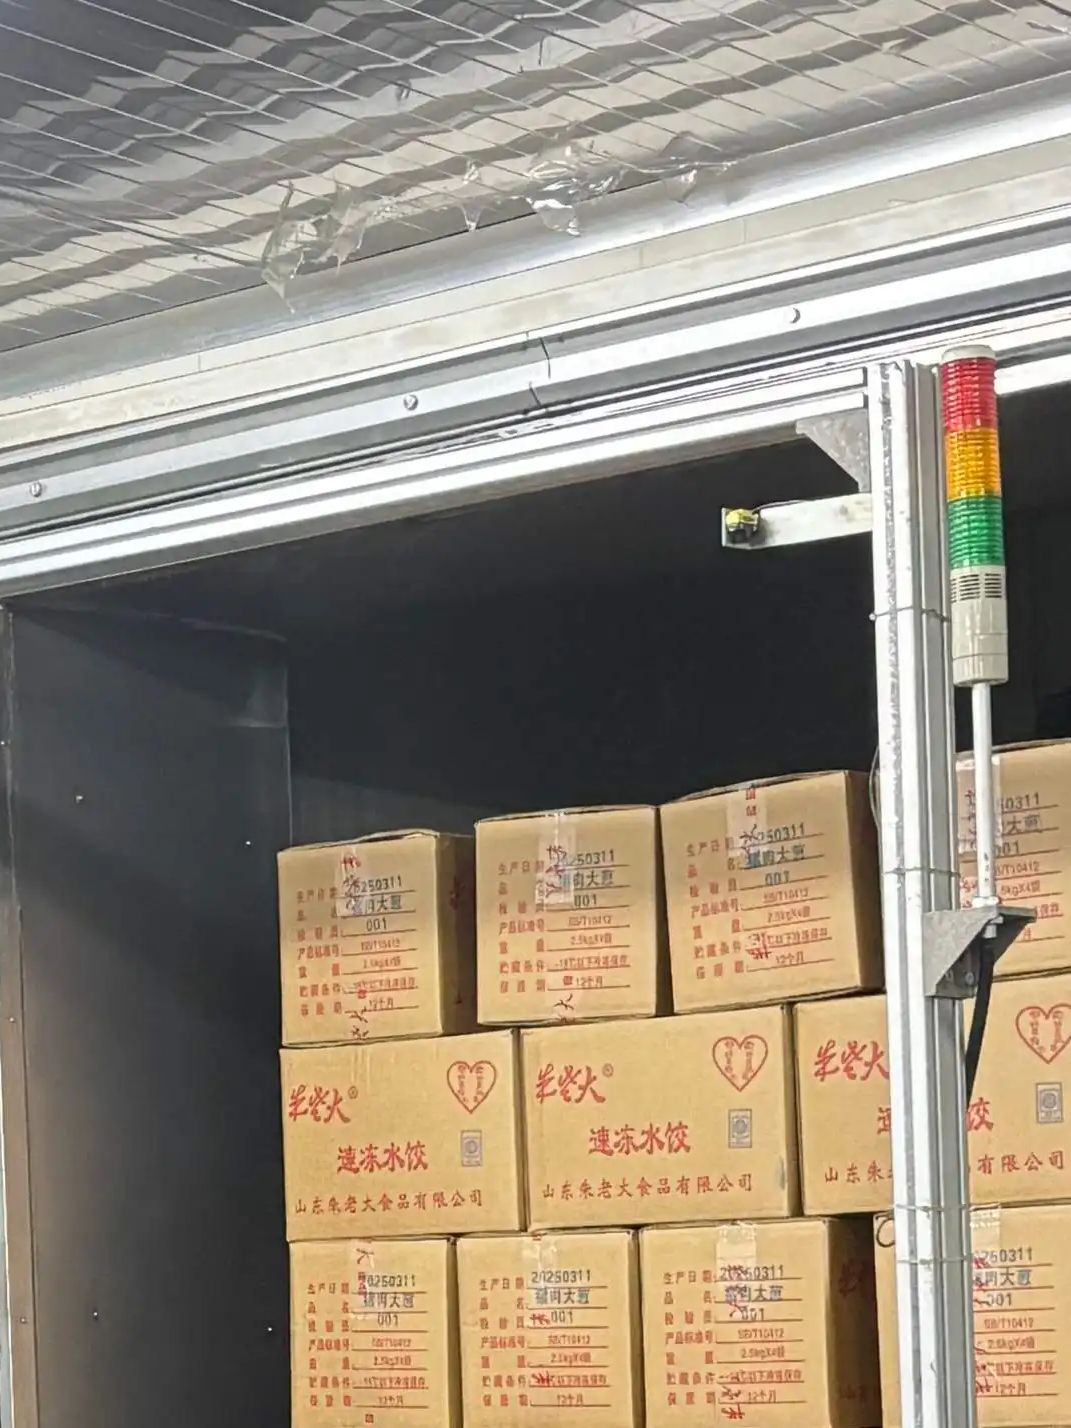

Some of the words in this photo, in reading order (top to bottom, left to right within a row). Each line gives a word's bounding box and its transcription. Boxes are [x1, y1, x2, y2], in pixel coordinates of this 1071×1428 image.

[745, 822, 805, 846] 50311
[996, 860, 1041, 876] /T10412
[366, 917, 387, 931] 001
[588, 1121, 691, 1156] 速冻水饺
[337, 1141, 428, 1174] 速冻水饺
[543, 1173, 752, 1200] 山东朱老大食品有限公司
[295, 1189, 482, 1215] 山东朱老大食品有限公司
[977, 1247, 1033, 1263] 50311
[362, 1274, 416, 1288] 0250311
[551, 1310, 574, 1324] 001
[995, 1382, 1026, 1396] 12个月
